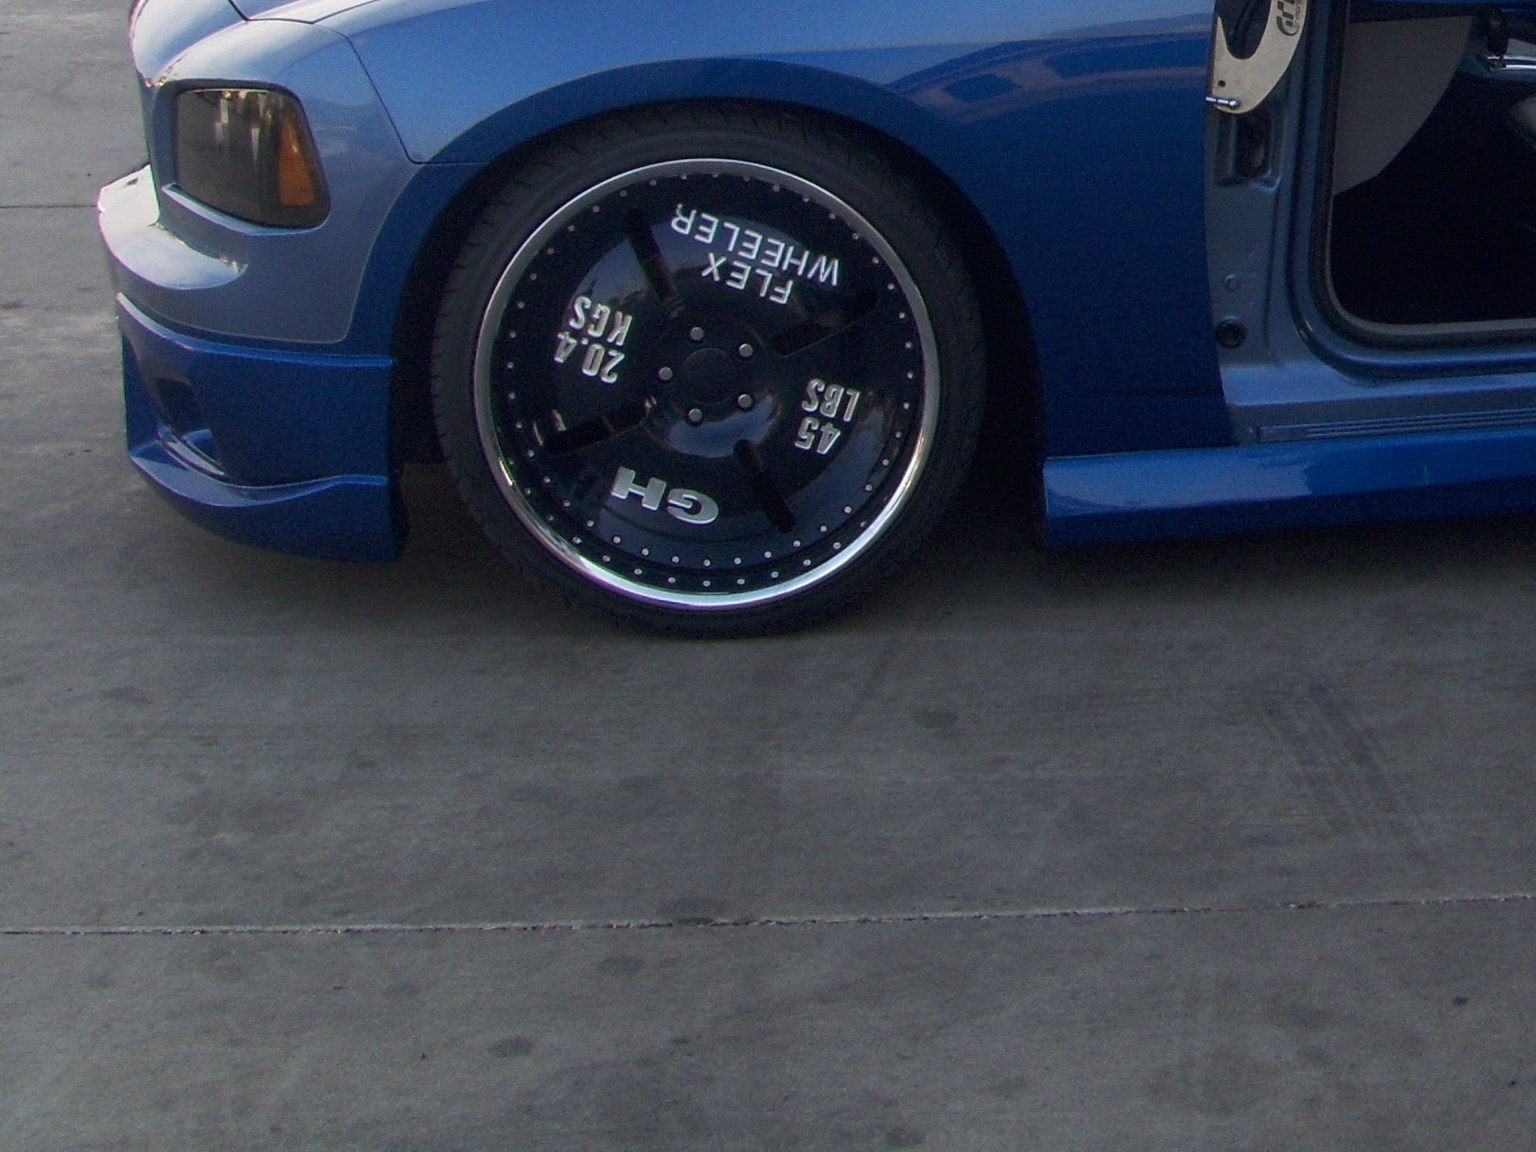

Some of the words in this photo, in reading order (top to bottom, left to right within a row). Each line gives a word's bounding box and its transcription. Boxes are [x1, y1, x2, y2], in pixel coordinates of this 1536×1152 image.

[671, 203, 839, 286] WHEELER
[701, 252, 794, 305] FLEX
[569, 296, 632, 346] KGS
[553, 331, 625, 383] 20.4
[801, 378, 861, 422] LBS
[794, 417, 841, 455] 45
[611, 467, 719, 526] GH
